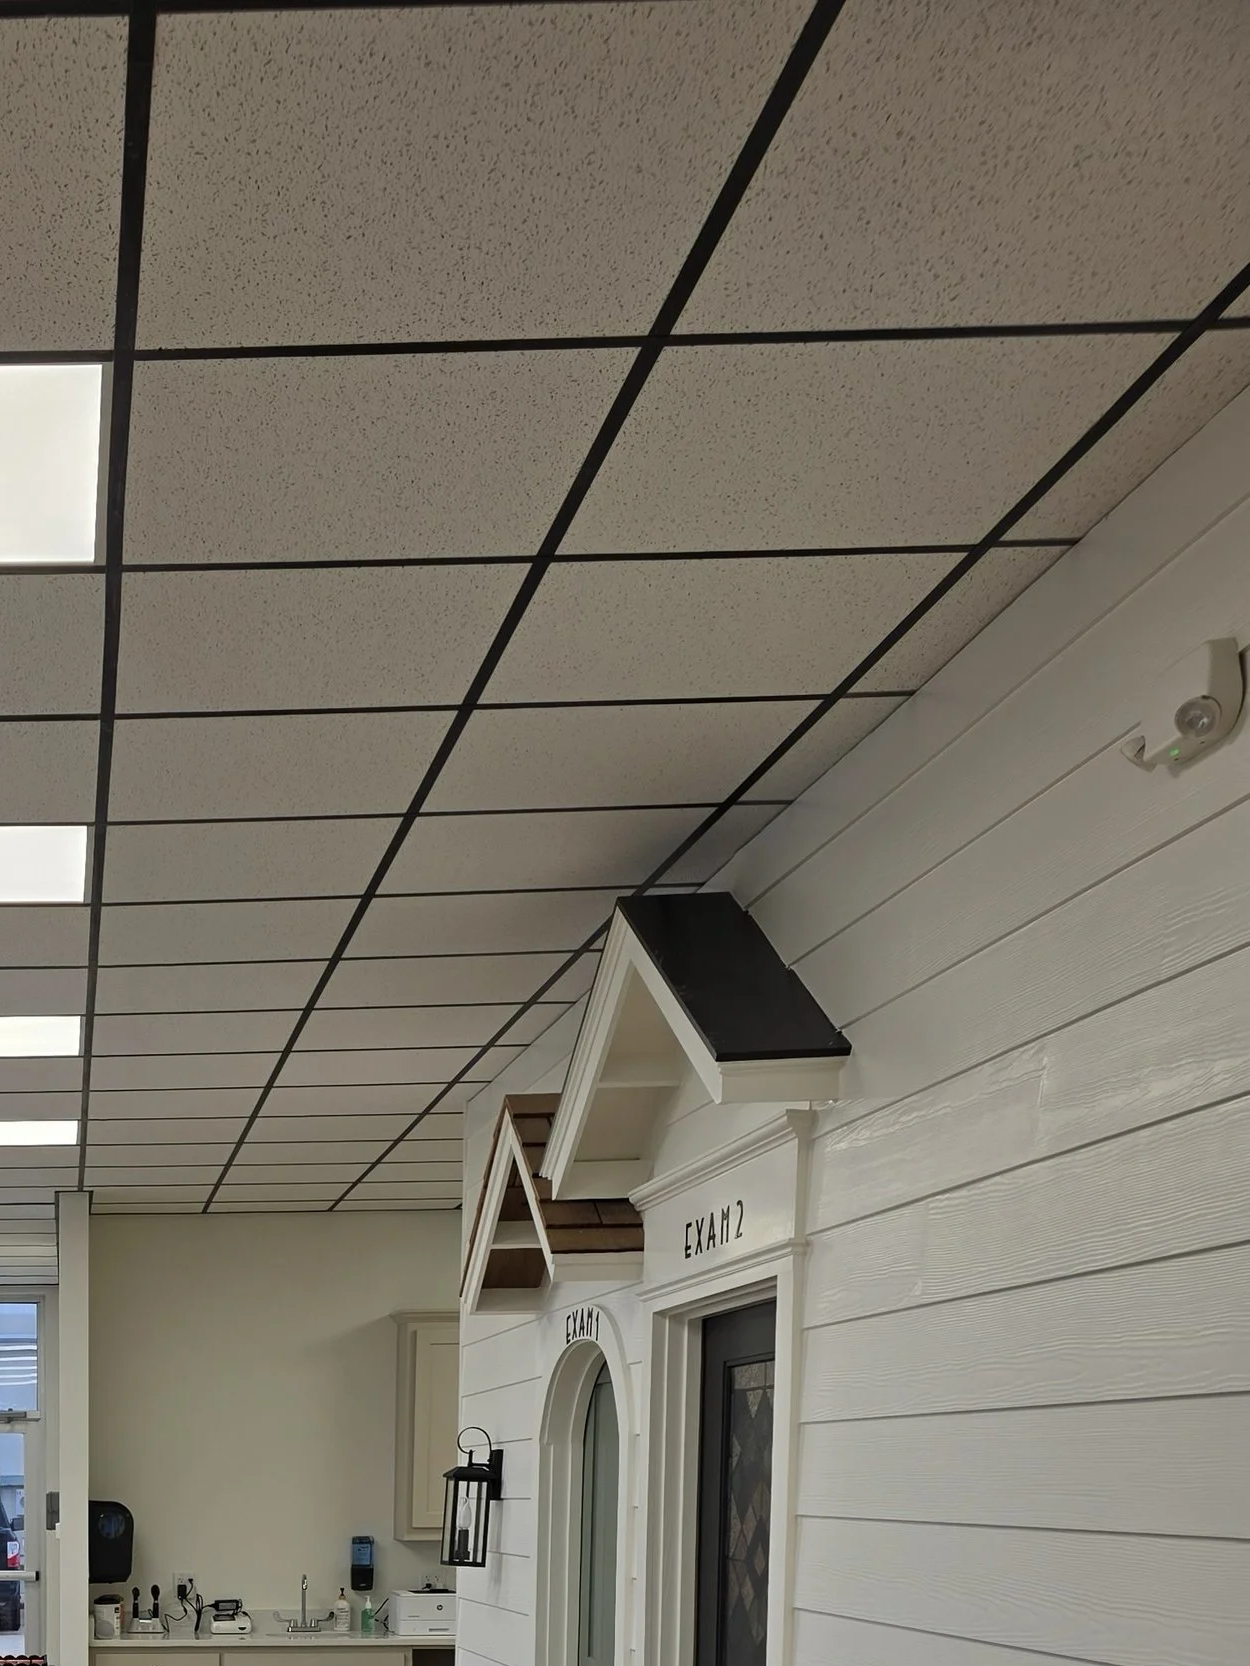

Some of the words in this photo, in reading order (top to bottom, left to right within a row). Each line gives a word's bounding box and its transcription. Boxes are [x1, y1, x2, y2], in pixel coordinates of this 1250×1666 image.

[684, 1205, 730, 1259] EXAM
[735, 1200, 743, 1239] 2
[566, 1307, 593, 1345] EXAM
[595, 1311, 599, 1341] 1
